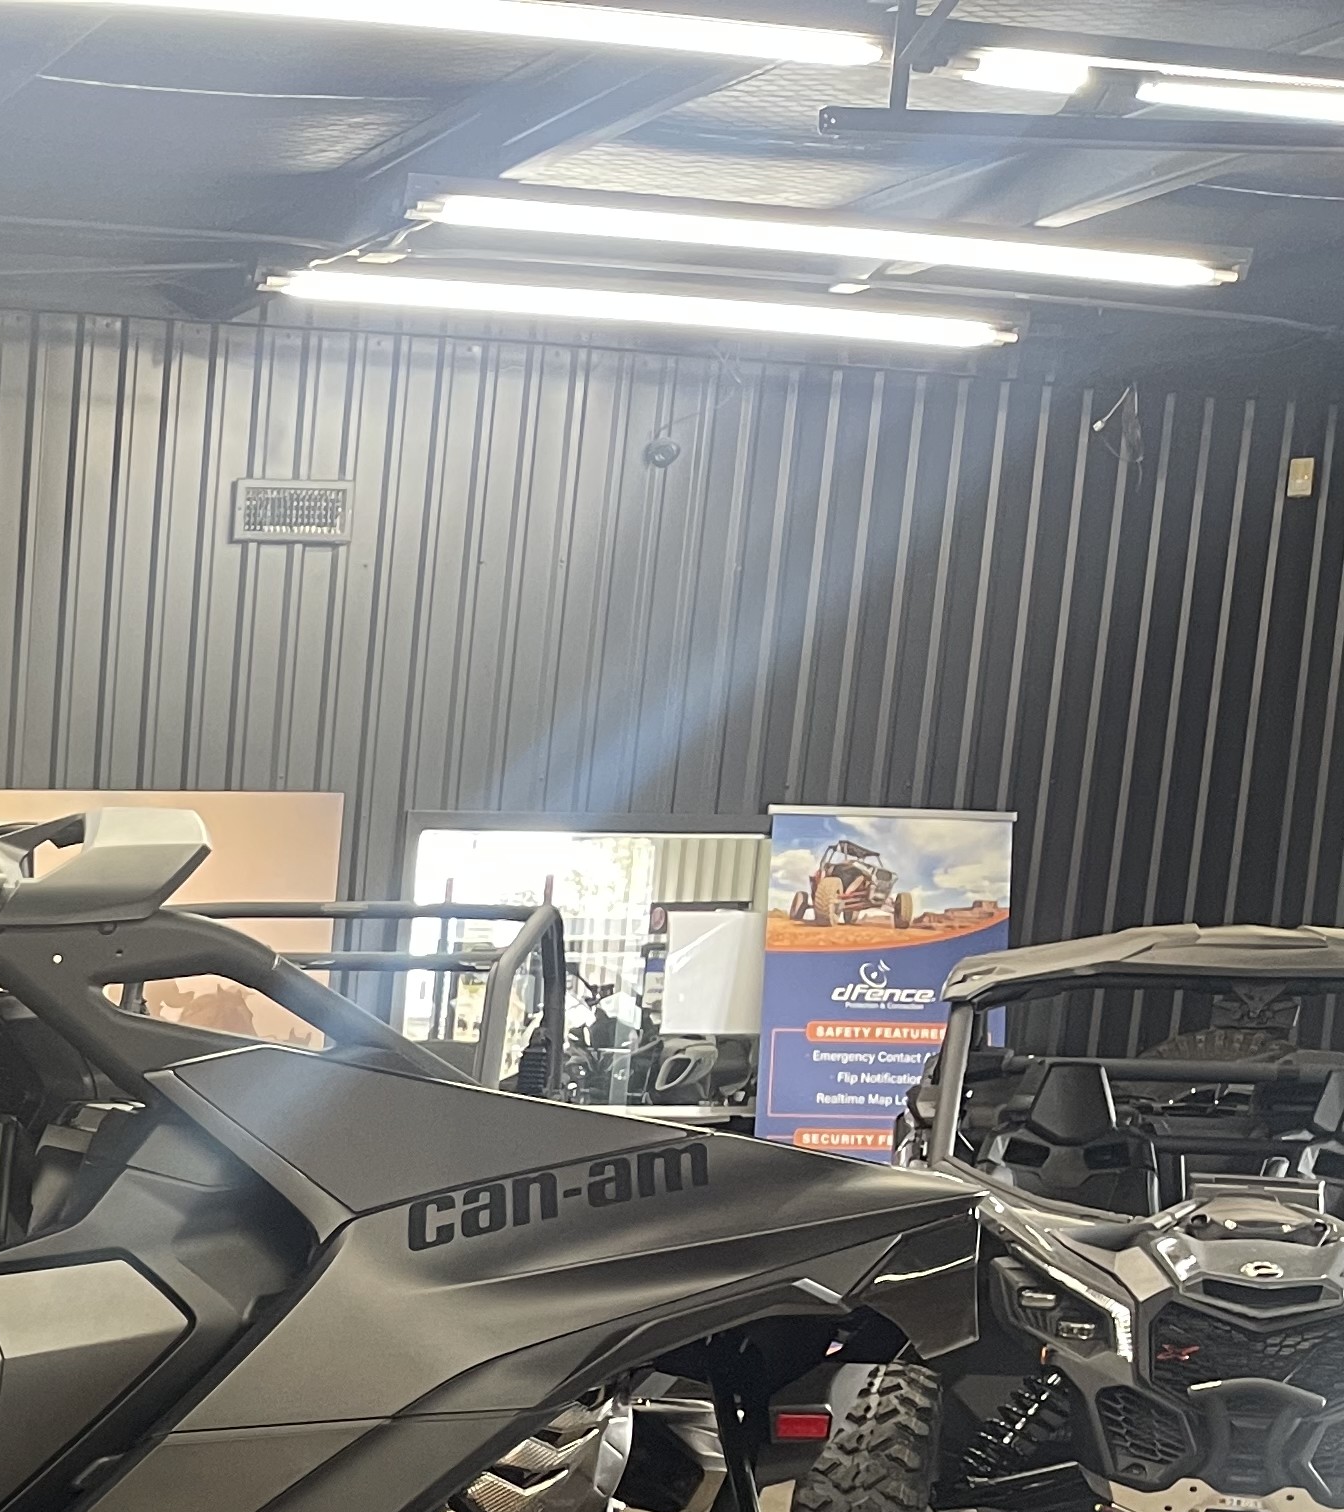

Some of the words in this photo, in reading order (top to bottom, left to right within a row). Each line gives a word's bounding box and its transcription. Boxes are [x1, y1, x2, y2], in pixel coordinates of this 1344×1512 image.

[816, 1026, 871, 1039] SAFETY
[813, 1050, 875, 1064] Emergency
[878, 1051, 920, 1063] Contact
[837, 1072, 858, 1085] Flip
[816, 1093, 865, 1105] Realtime
[868, 1094, 892, 1107] Map
[802, 1133, 874, 1146] SECURITY
[408, 1143, 709, 1252] can-am
